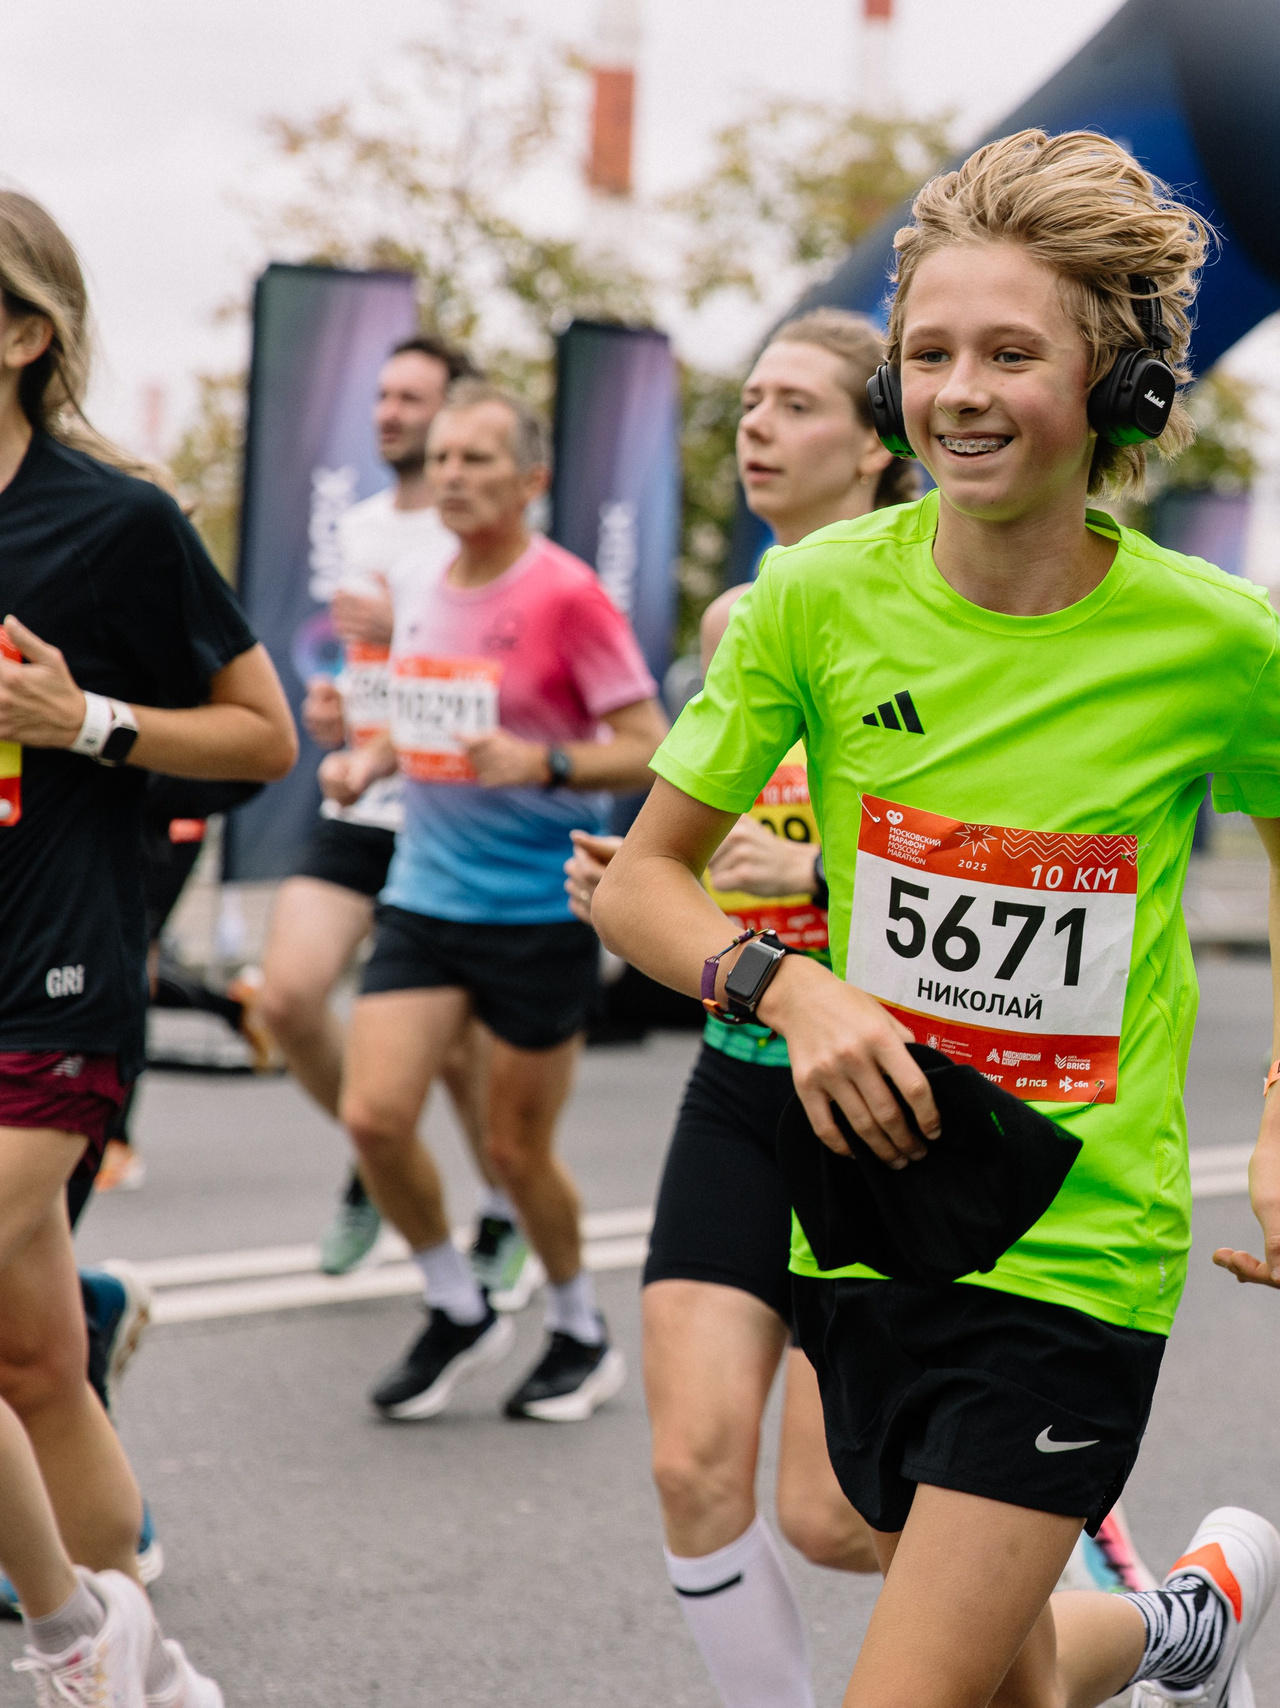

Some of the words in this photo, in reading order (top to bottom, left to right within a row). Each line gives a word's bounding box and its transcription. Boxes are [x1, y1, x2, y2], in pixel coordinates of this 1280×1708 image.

[888, 833, 926, 851] МАРАФОН
[889, 826, 942, 847] МОСКОВСКИЙ
[887, 841, 920, 856] MOSCOW
[886, 848, 927, 866] MARATHON
[957, 859, 988, 872] 2025
[1030, 864, 1064, 889] 10
[885, 876, 1088, 987] 5671
[917, 977, 1043, 1020] НИКОЛАЙ
[1001, 1058, 1020, 1067] СПОРТ
[1003, 1050, 1042, 1061] МОСКОВСКИЙ
[1066, 1062, 1091, 1070] BRICS
[1028, 1079, 1048, 1087] ПСБ
[1073, 1080, 1089, 1088] сбп
